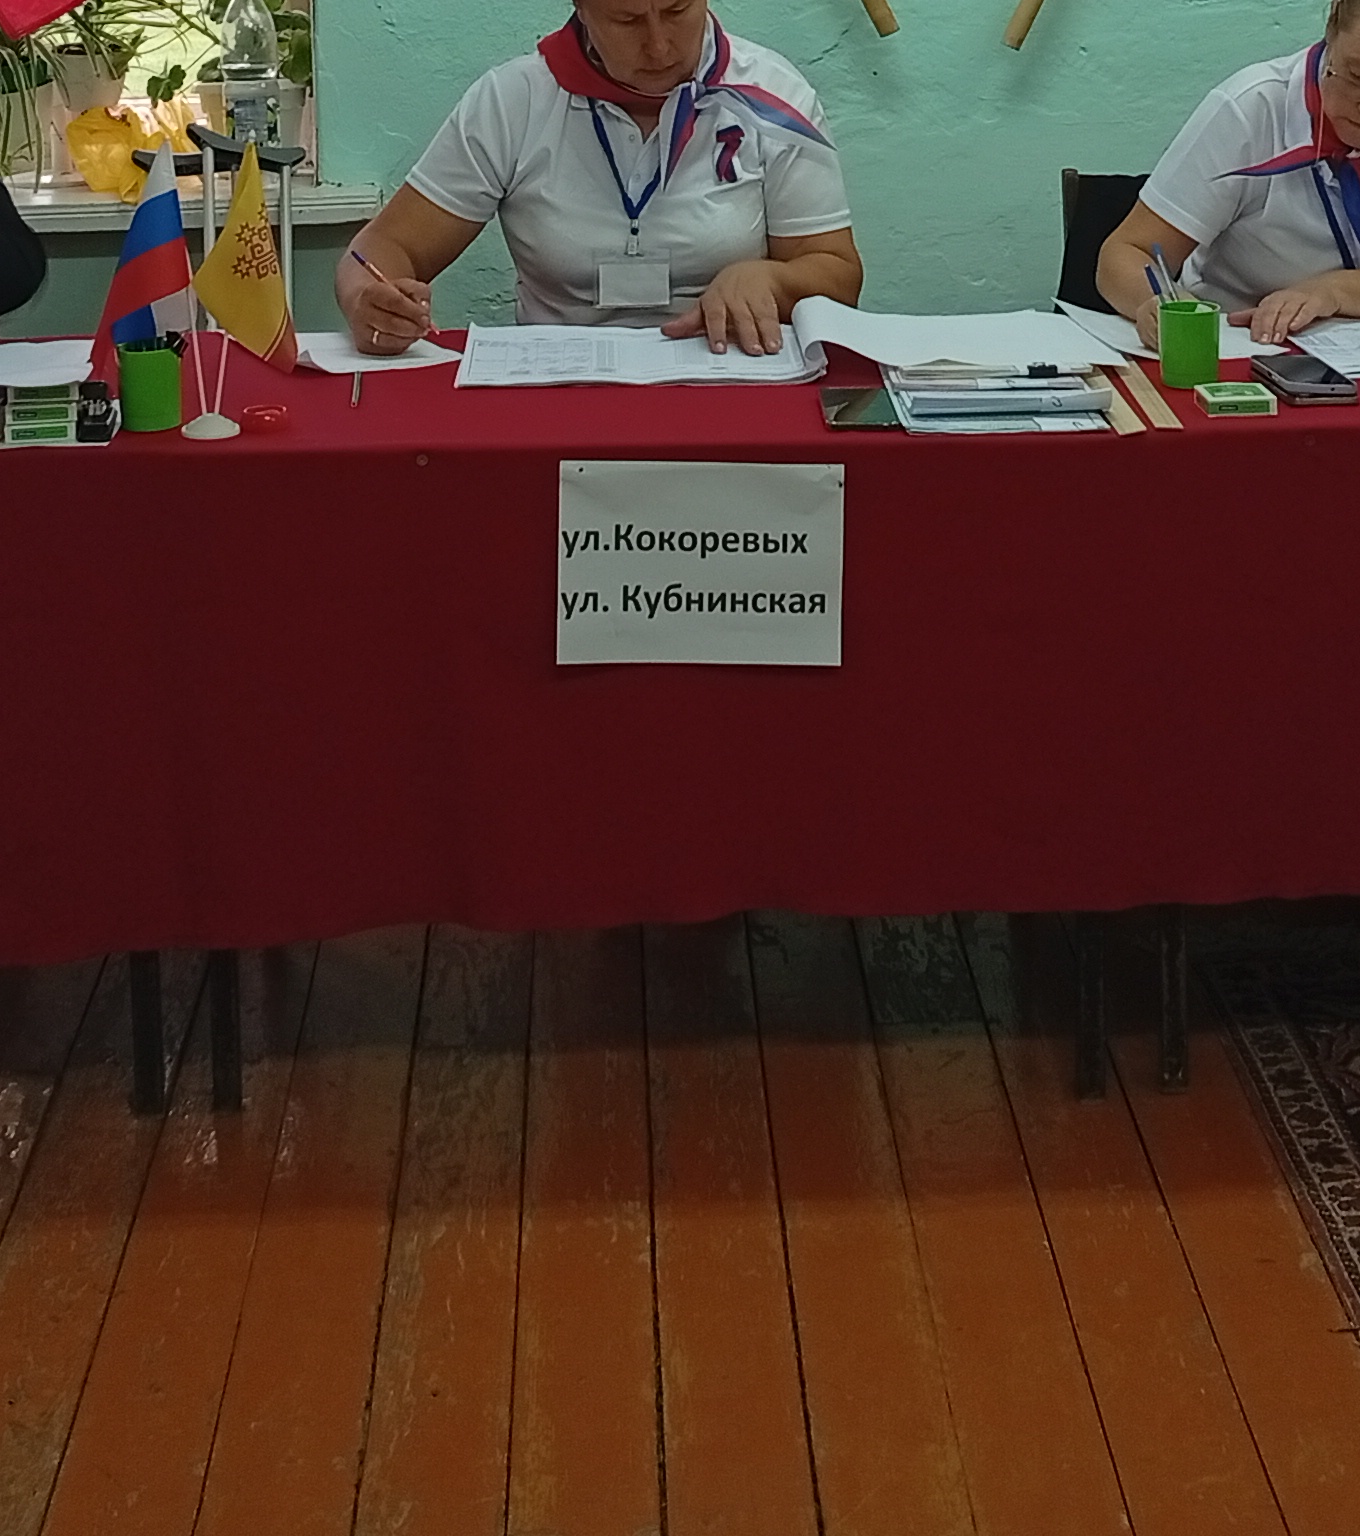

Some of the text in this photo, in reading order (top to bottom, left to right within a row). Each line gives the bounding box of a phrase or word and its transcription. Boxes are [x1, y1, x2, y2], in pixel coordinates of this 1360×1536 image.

[561, 523, 808, 559] ул.Кокоревых
[561, 583, 827, 619] ул. Кубнинская
